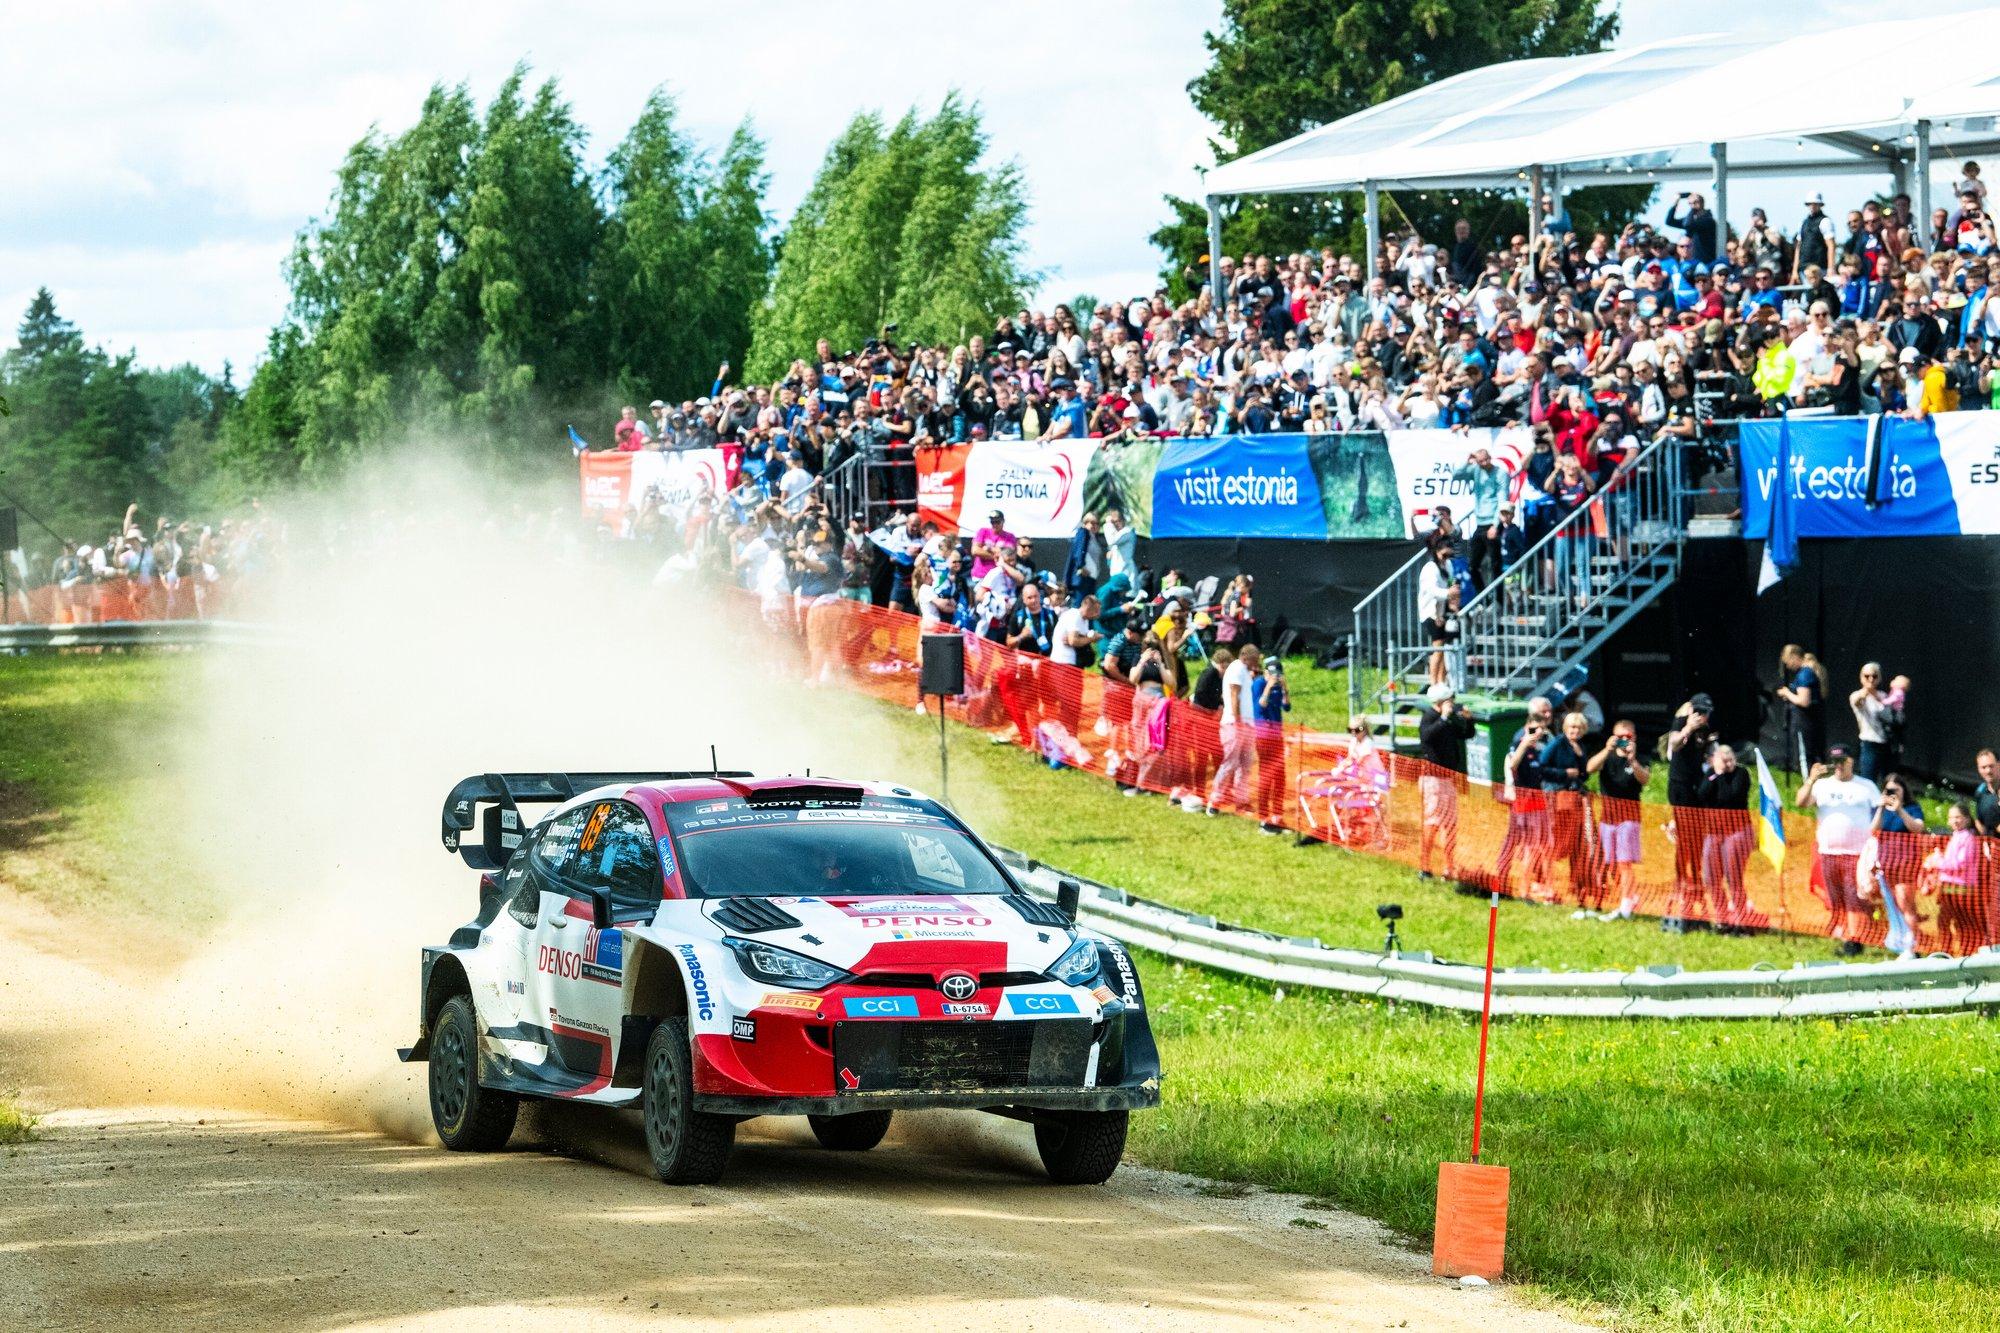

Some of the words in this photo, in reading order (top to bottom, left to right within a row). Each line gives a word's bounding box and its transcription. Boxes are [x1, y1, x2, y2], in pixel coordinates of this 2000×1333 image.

[1000, 468, 1034, 481] RALLY
[1808, 454, 1917, 500] estoia
[985, 483, 1049, 499] ESTONIA
[1174, 467, 1223, 505] visit
[1223, 466, 1298, 505] estonia
[732, 799, 802, 809] TOYOTA
[804, 799, 865, 808] GAZOO
[868, 801, 923, 813] Racing
[683, 812, 789, 829] BEYOND
[807, 811, 889, 820] RALLY
[861, 916, 992, 928] DENSO
[913, 929, 975, 939] Microsoft
[539, 944, 582, 981] DENSO
[674, 943, 716, 1022] Panasonic
[764, 994, 817, 1009] PIRELLI
[952, 1005, 983, 1013] A-6754
[733, 1023, 755, 1037] OMP
